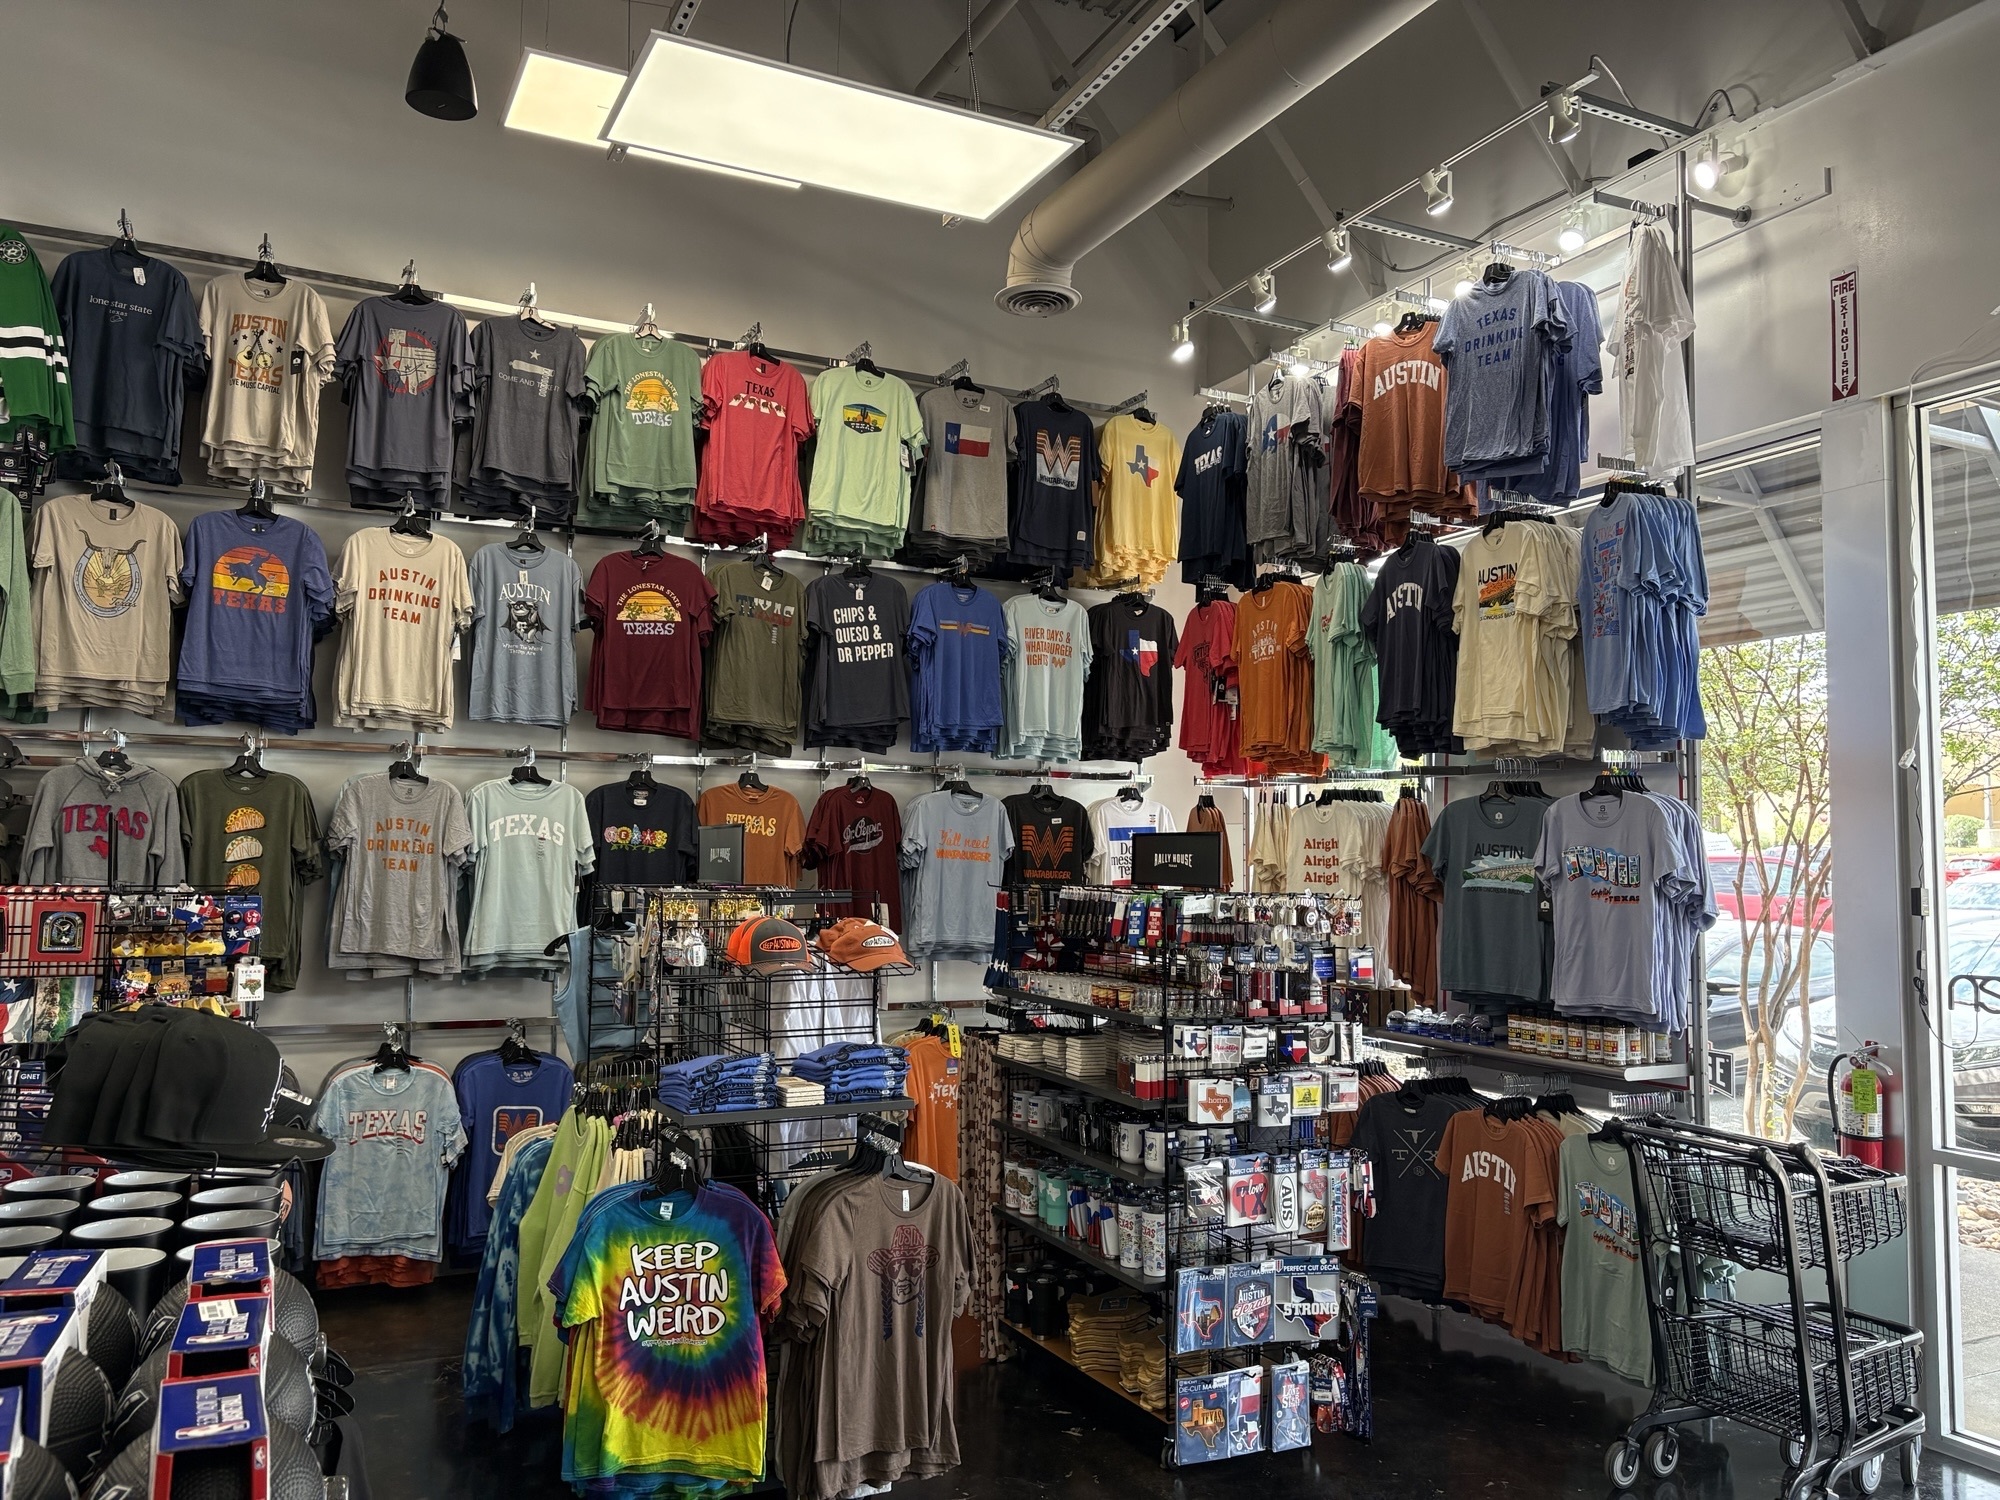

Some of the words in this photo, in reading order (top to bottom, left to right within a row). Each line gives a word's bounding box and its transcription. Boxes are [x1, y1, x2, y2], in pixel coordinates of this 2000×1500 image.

[1832, 279, 1855, 297] FIRE
[89, 294, 109, 306] lone
[110, 300, 127, 310] star
[129, 303, 153, 315] state
[108, 309, 128, 317] texas
[1476, 307, 1518, 330] TEXAS
[230, 313, 288, 343] AUSTIN
[1840, 296, 1849, 392] EXTINGUISHER
[1477, 348, 1511, 368] TEAM
[228, 357, 285, 386] TEXAS
[498, 372, 519, 383] COME
[519, 378, 535, 387] AND
[1373, 359, 1441, 401] AUSTIN
[240, 380, 257, 389] MUSIC
[257, 382, 280, 394] CAPITAL
[624, 382, 633, 395] THE
[632, 371, 664, 383] LONESTAR
[664, 379, 679, 397] STATE
[745, 380, 775, 398] TEXAS
[632, 411, 673, 427] TEXAS
[1194, 445, 1222, 475] TEXAS
[379, 568, 437, 592] AUSTIN
[1478, 562, 1518, 586] AUSTIN
[108, 597, 137, 609] Texas
[212, 589, 287, 614] TEXAS
[368, 587, 441, 610] DRINKING
[499, 583, 551, 606] AUSTIN
[616, 593, 628, 606] THE
[627, 583, 665, 594] LONESTAR
[665, 589, 681, 608] STATE
[382, 606, 422, 625] TEAM
[833, 608, 865, 624] CHIPS
[868, 605, 877, 621] &
[623, 622, 675, 635] TEXAS
[835, 626, 870, 644] QUESO
[873, 624, 882, 639] &
[1024, 627, 1045, 640] RIVER
[1046, 629, 1064, 643] DAYS
[1066, 631, 1071, 644] &
[837, 646, 853, 663] DR
[855, 642, 894, 662] PEPPER
[1025, 640, 1073, 658] WHATABURGER
[62, 803, 149, 840] TEXAS
[376, 817, 431, 837] AUSTIN
[488, 813, 566, 846] TEXAS
[725, 812, 777, 837] TEXAS
[609, 829, 663, 844] TEXAS
[963, 834, 990, 849] need
[1304, 838, 1339, 852] Alrigh
[367, 838, 435, 856] DRINKING
[936, 848, 992, 862] WHATABURGER
[1474, 843, 1524, 860] AUSTIN
[1154, 853, 1172, 867] RALLY
[1172, 853, 1193, 868] HOUSE
[1304, 855, 1339, 869] Alrigh
[1564, 845, 1641, 888] AUSTIN
[1023, 869, 1072, 880] WHATABURGER
[1304, 871, 1339, 885] Alrigh
[1213, 1044, 1240, 1053] Austin
[1208, 1096, 1229, 1104] home
[350, 1110, 427, 1145] TEXAS
[1248, 1178, 1265, 1196] love
[1281, 1185, 1293, 1221] AUS
[893, 1226, 924, 1247] AUSTIN
[631, 1241, 719, 1276] KEEP
[1320, 1263, 1339, 1271] DECAL
[1199, 1273, 1225, 1282] MAGNET
[1229, 1270, 1250, 1278] DIE-CUT
[620, 1268, 729, 1311] AUSTIN
[1238, 1289, 1266, 1303] AUSTIN
[1236, 1298, 1270, 1317] Texas
[1283, 1302, 1340, 1316] STRONG
[627, 1303, 726, 1342] WEIRD
[1179, 1385, 1201, 1394] DIE-CUT
[1282, 1396, 1300, 1409] STAR
[1202, 1411, 1223, 1425] TEXAS
